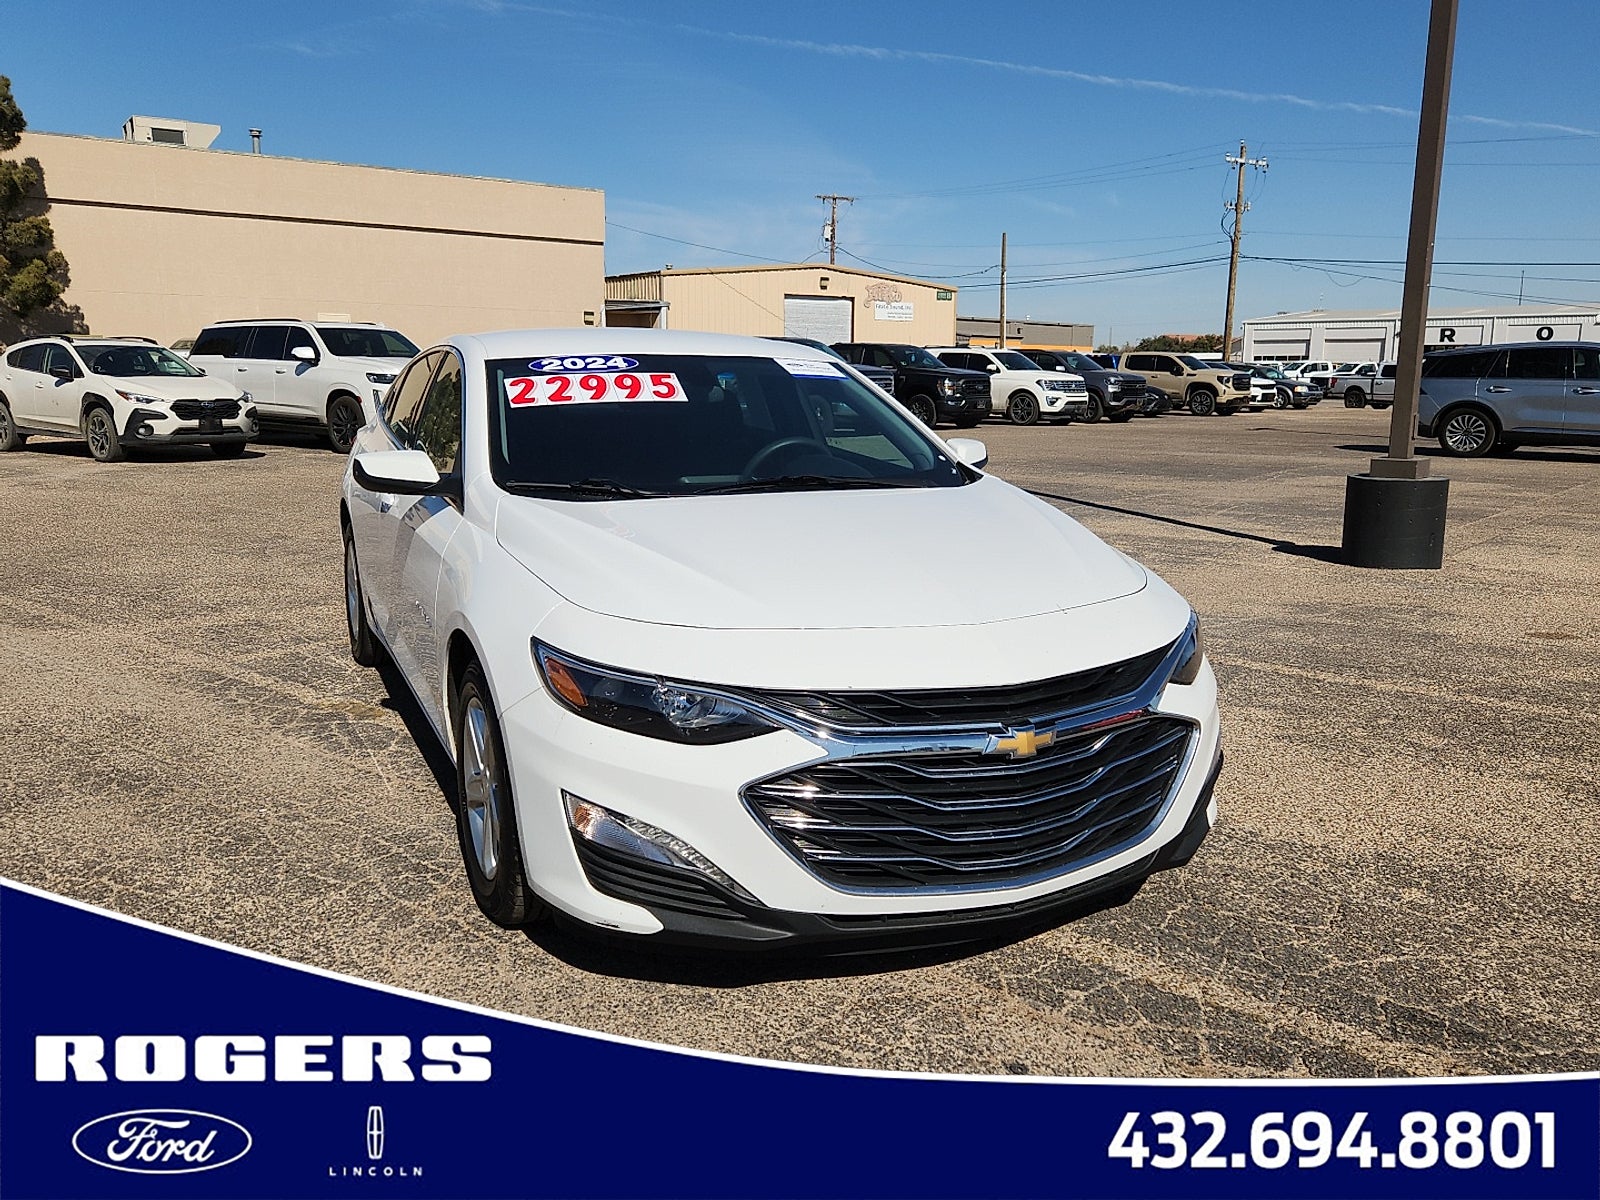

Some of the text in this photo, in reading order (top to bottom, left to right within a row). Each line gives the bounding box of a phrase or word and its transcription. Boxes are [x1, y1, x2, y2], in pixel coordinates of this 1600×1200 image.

[1439, 326, 1554, 343] R O
[541, 357, 629, 371] 2024
[509, 374, 679, 404] 22995
